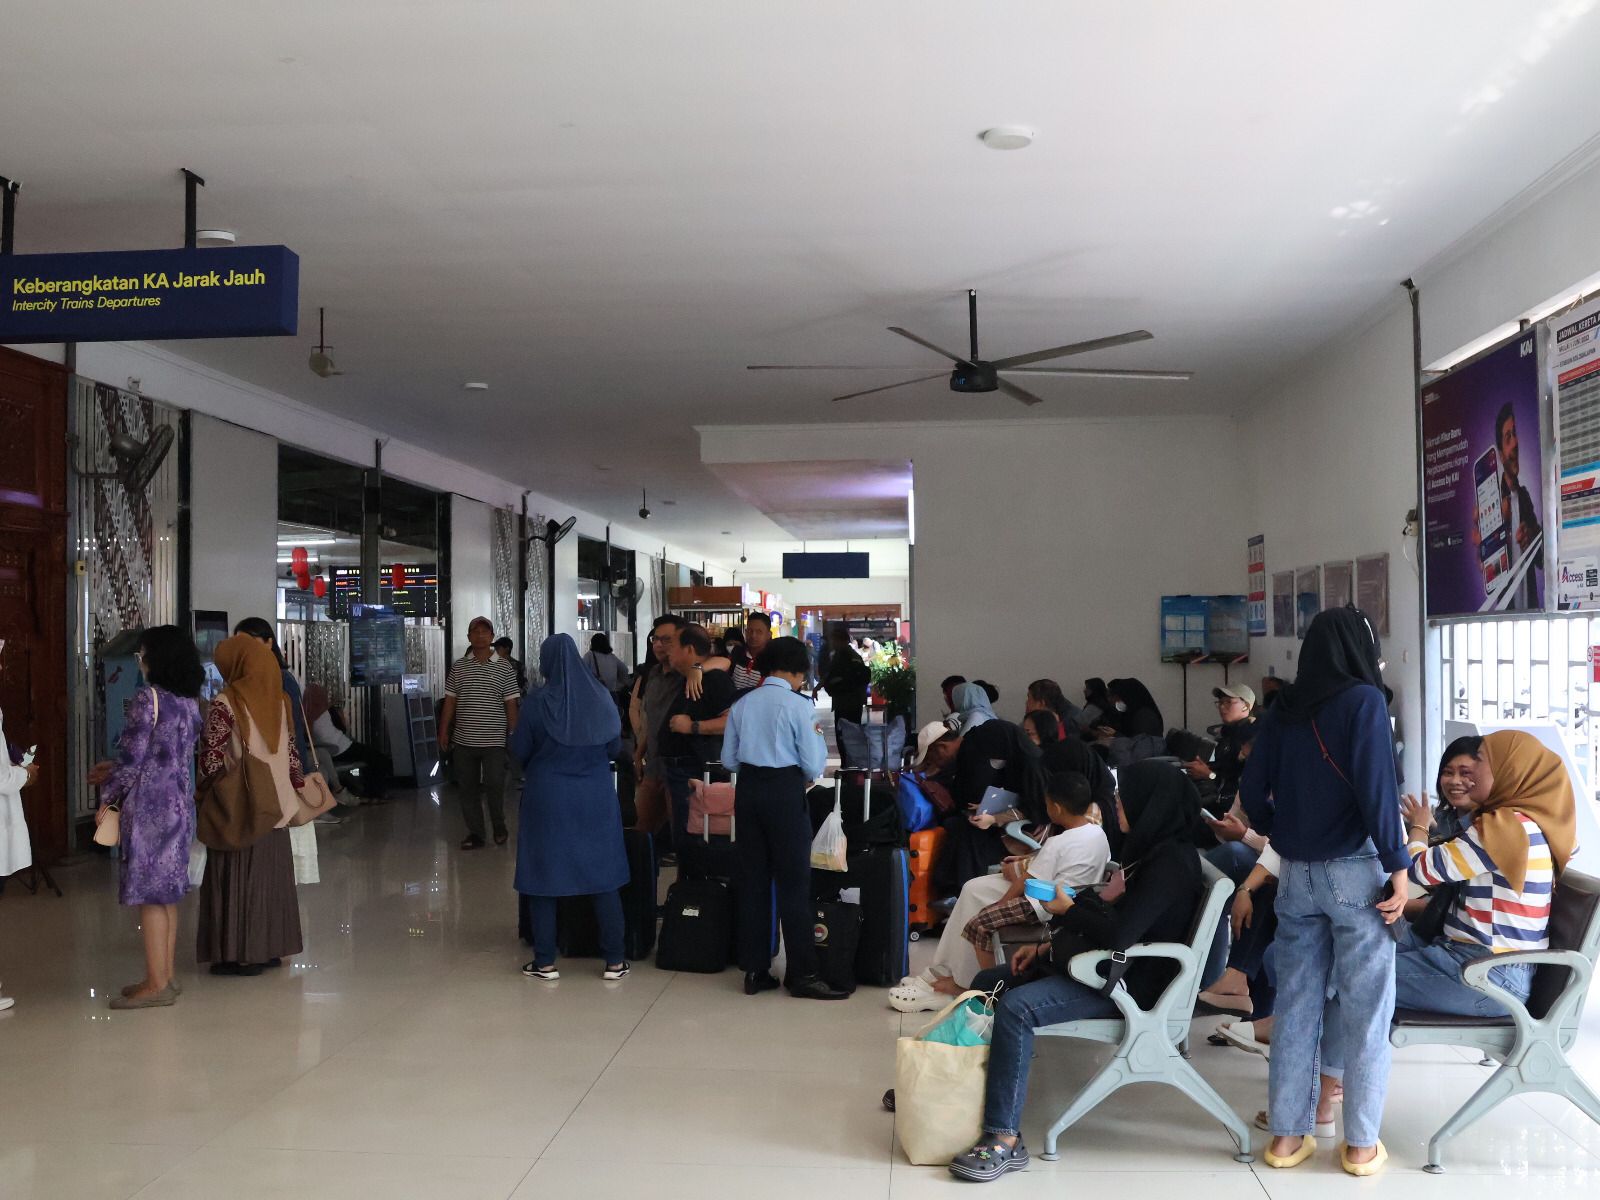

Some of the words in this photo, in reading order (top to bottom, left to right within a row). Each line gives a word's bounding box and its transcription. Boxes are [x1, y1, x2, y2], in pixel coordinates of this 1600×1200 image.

[13, 275, 139, 295] Keberangkatan
[143, 272, 169, 289] KA
[172, 271, 221, 288] Jarak
[223, 268, 266, 286] Jauh
[12, 298, 57, 313] Intercity
[60, 297, 95, 310] Trains
[97, 296, 161, 310] Departures
[1558, 324, 1577, 341] JADWAL
[1579, 315, 1597, 330] KERETA
[1520, 338, 1533, 358] KAI
[1561, 566, 1584, 583] Access
